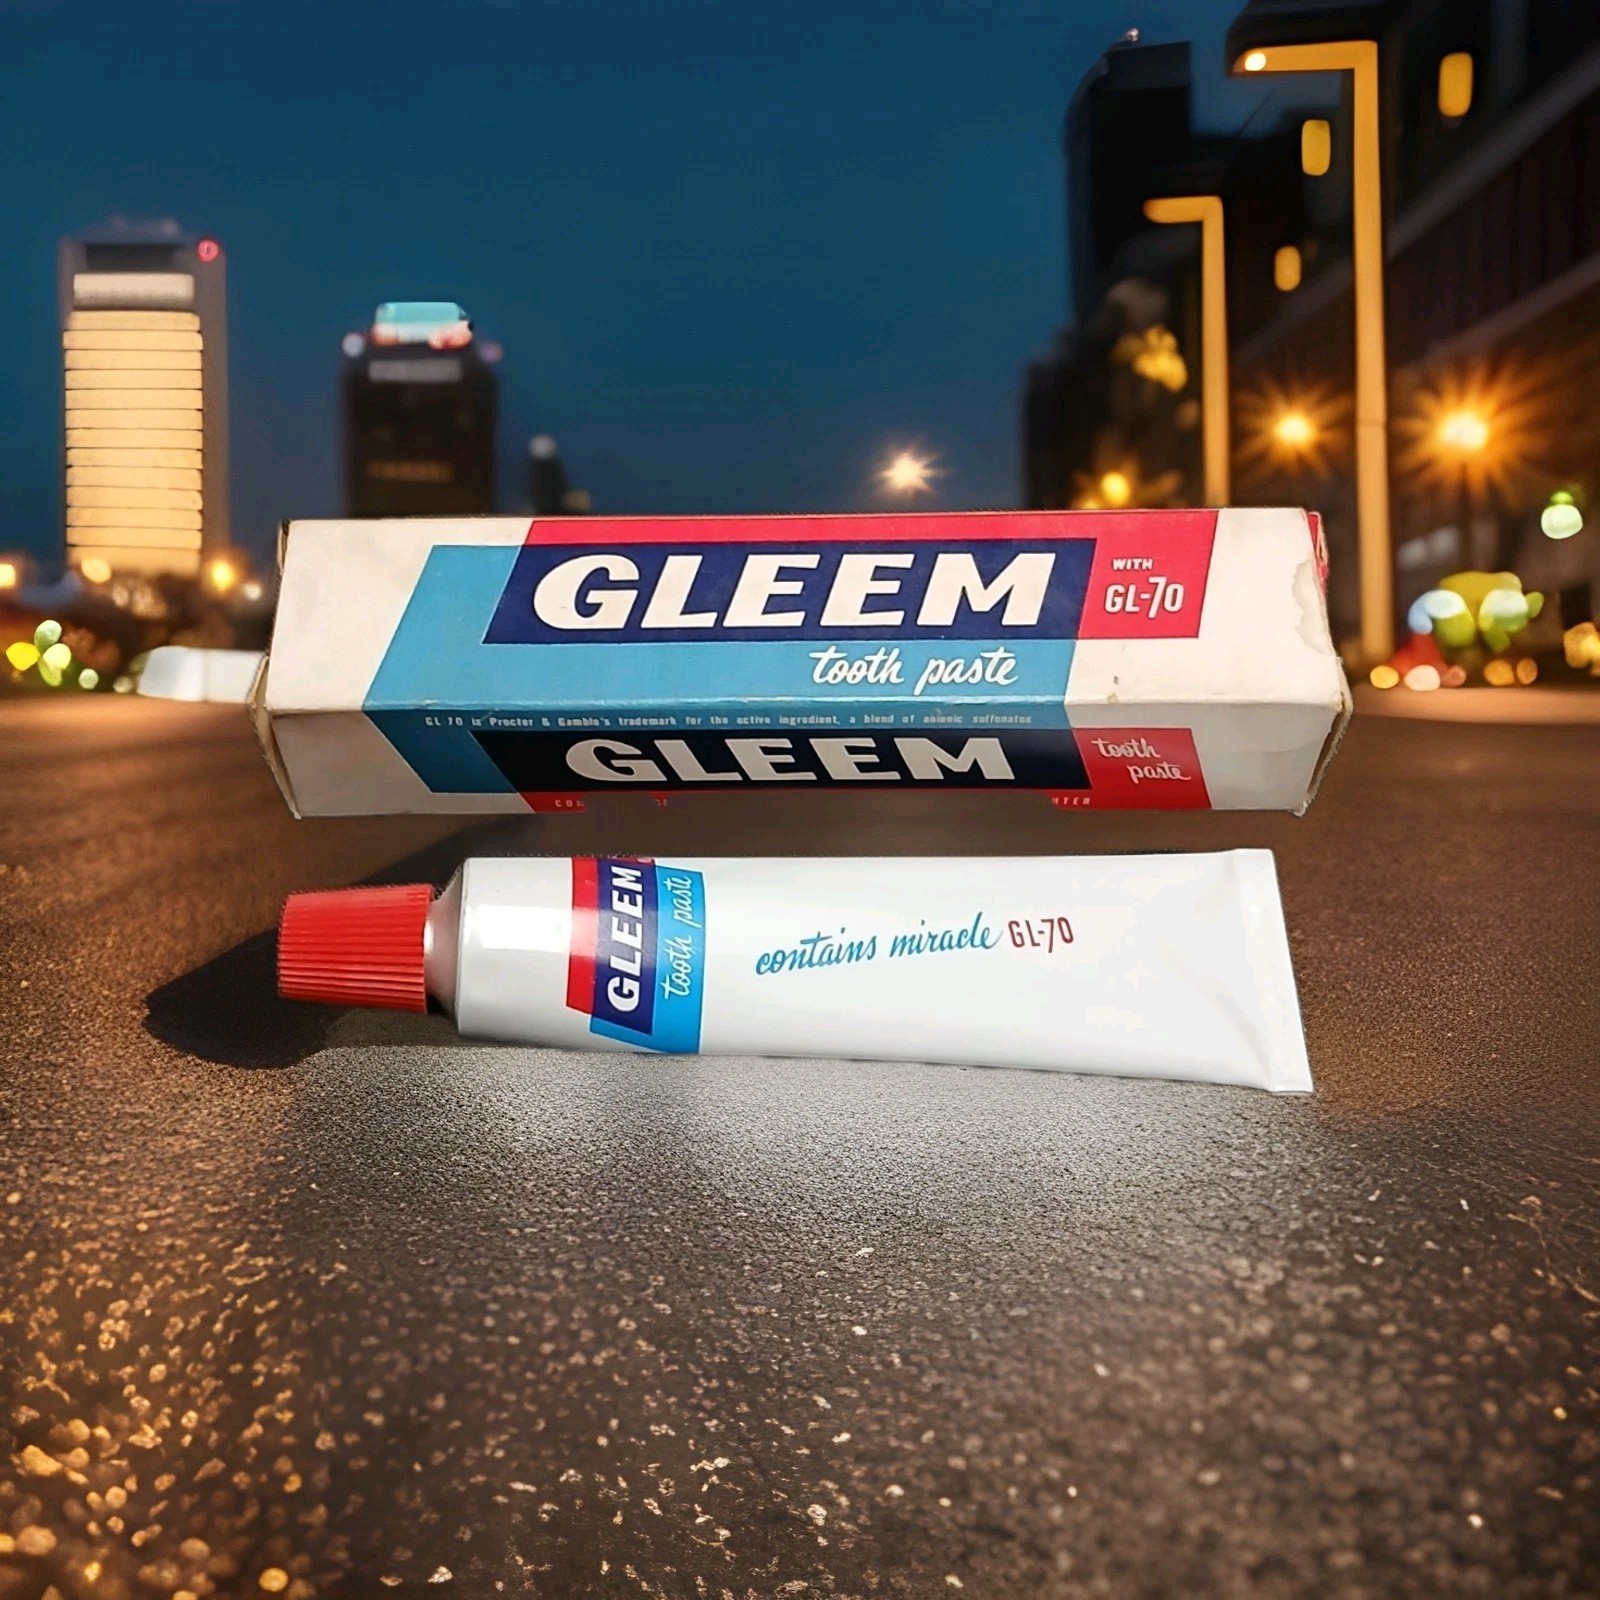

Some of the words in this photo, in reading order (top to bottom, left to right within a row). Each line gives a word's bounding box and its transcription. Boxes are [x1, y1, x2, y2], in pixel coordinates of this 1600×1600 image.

[1112, 558, 1153, 571] WITH
[533, 552, 1056, 630] GLEEM
[1104, 576, 1184, 618] GL-70
[809, 646, 904, 686] tooth
[913, 646, 1019, 696] paste
[424, 716, 442, 727] GL
[448, 716, 464, 727] 70
[471, 716, 483, 727] is
[489, 716, 535, 727] Procter
[557, 716, 611, 727] Gamble's
[618, 715, 677, 726] trademark
[685, 715, 702, 726] for
[709, 715, 729, 725] the
[736, 714, 771, 725] active
[779, 714, 841, 726] ingredient,
[848, 715, 857, 724] a
[863, 714, 895, 724] blend
[902, 714, 915, 724] of
[922, 713, 963, 724] anionic
[972, 714, 1033, 724] sulfonates
[566, 737, 1016, 782] GLEEM
[1091, 737, 1161, 758] tooth
[1127, 762, 1192, 784] paste
[607, 866, 643, 1012] GLEEM
[755, 926, 877, 975] contains
[889, 911, 1003, 957] miracle
[1008, 916, 1075, 953] GL-70
[659, 934, 693, 1000] tooth
